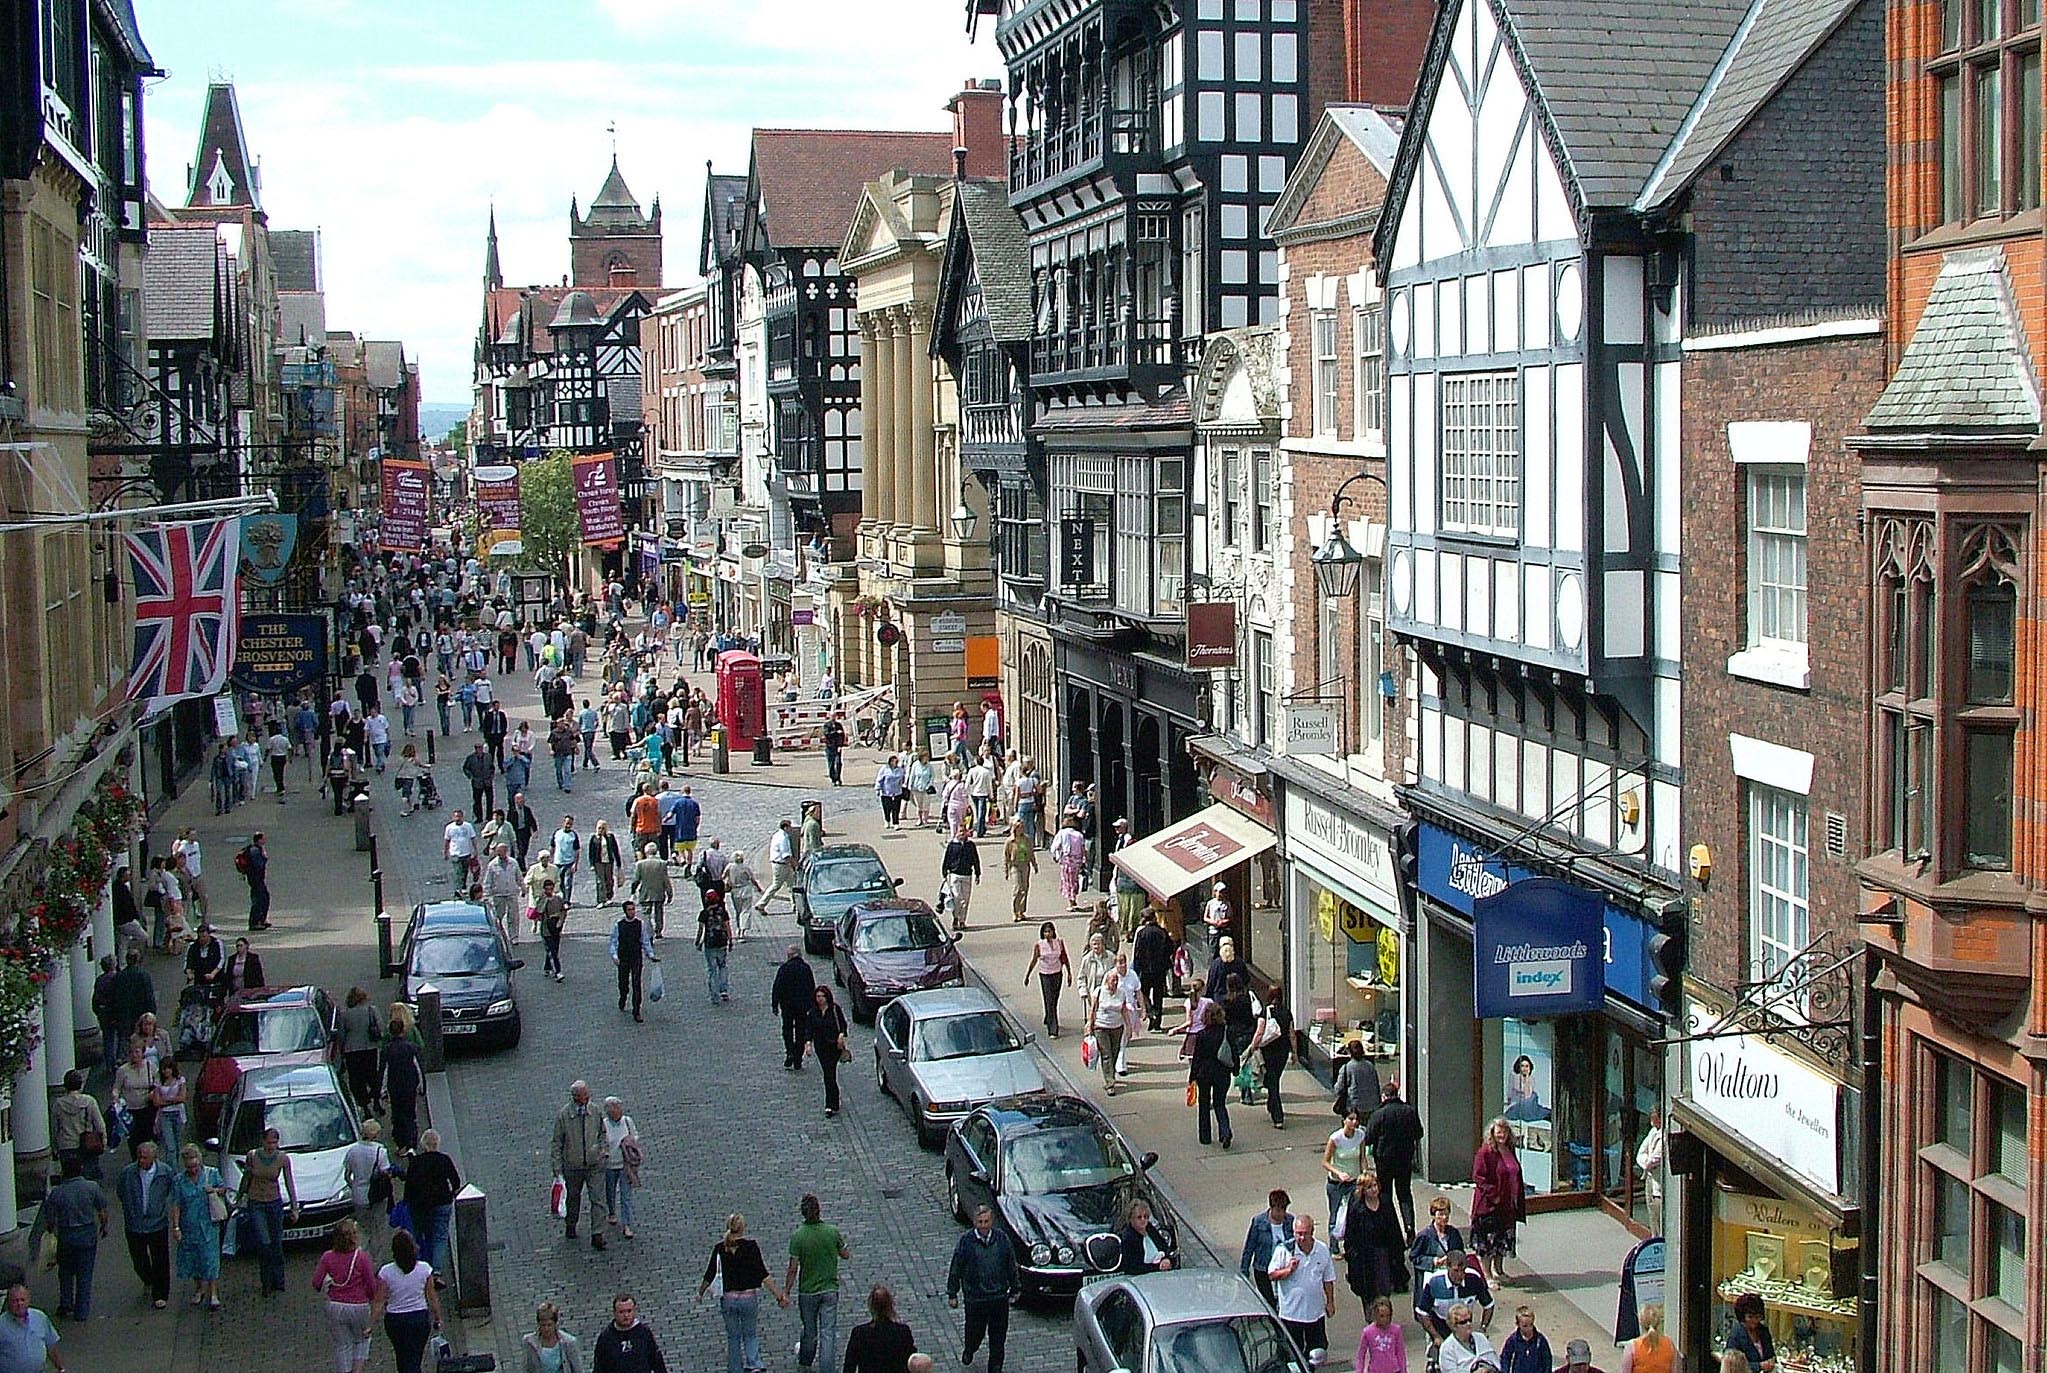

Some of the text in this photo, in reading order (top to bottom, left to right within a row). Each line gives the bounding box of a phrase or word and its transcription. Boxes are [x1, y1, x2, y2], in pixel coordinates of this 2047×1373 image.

[1072, 523, 1083, 581] NEXT
[257, 623, 288, 635] THE
[241, 637, 304, 649] CHESTER
[1190, 643, 1234, 658] Thorntons
[1292, 717, 1329, 729] Russell
[1294, 729, 1332, 742] Bromley
[1304, 798, 1336, 846] Russell
[1340, 818, 1382, 878] Bromley
[1494, 940, 1587, 964] Littlewoods
[1516, 970, 1564, 988] index
[1698, 1052, 1779, 1099] Waltons
[1785, 1101, 1830, 1140] the Jewellers
